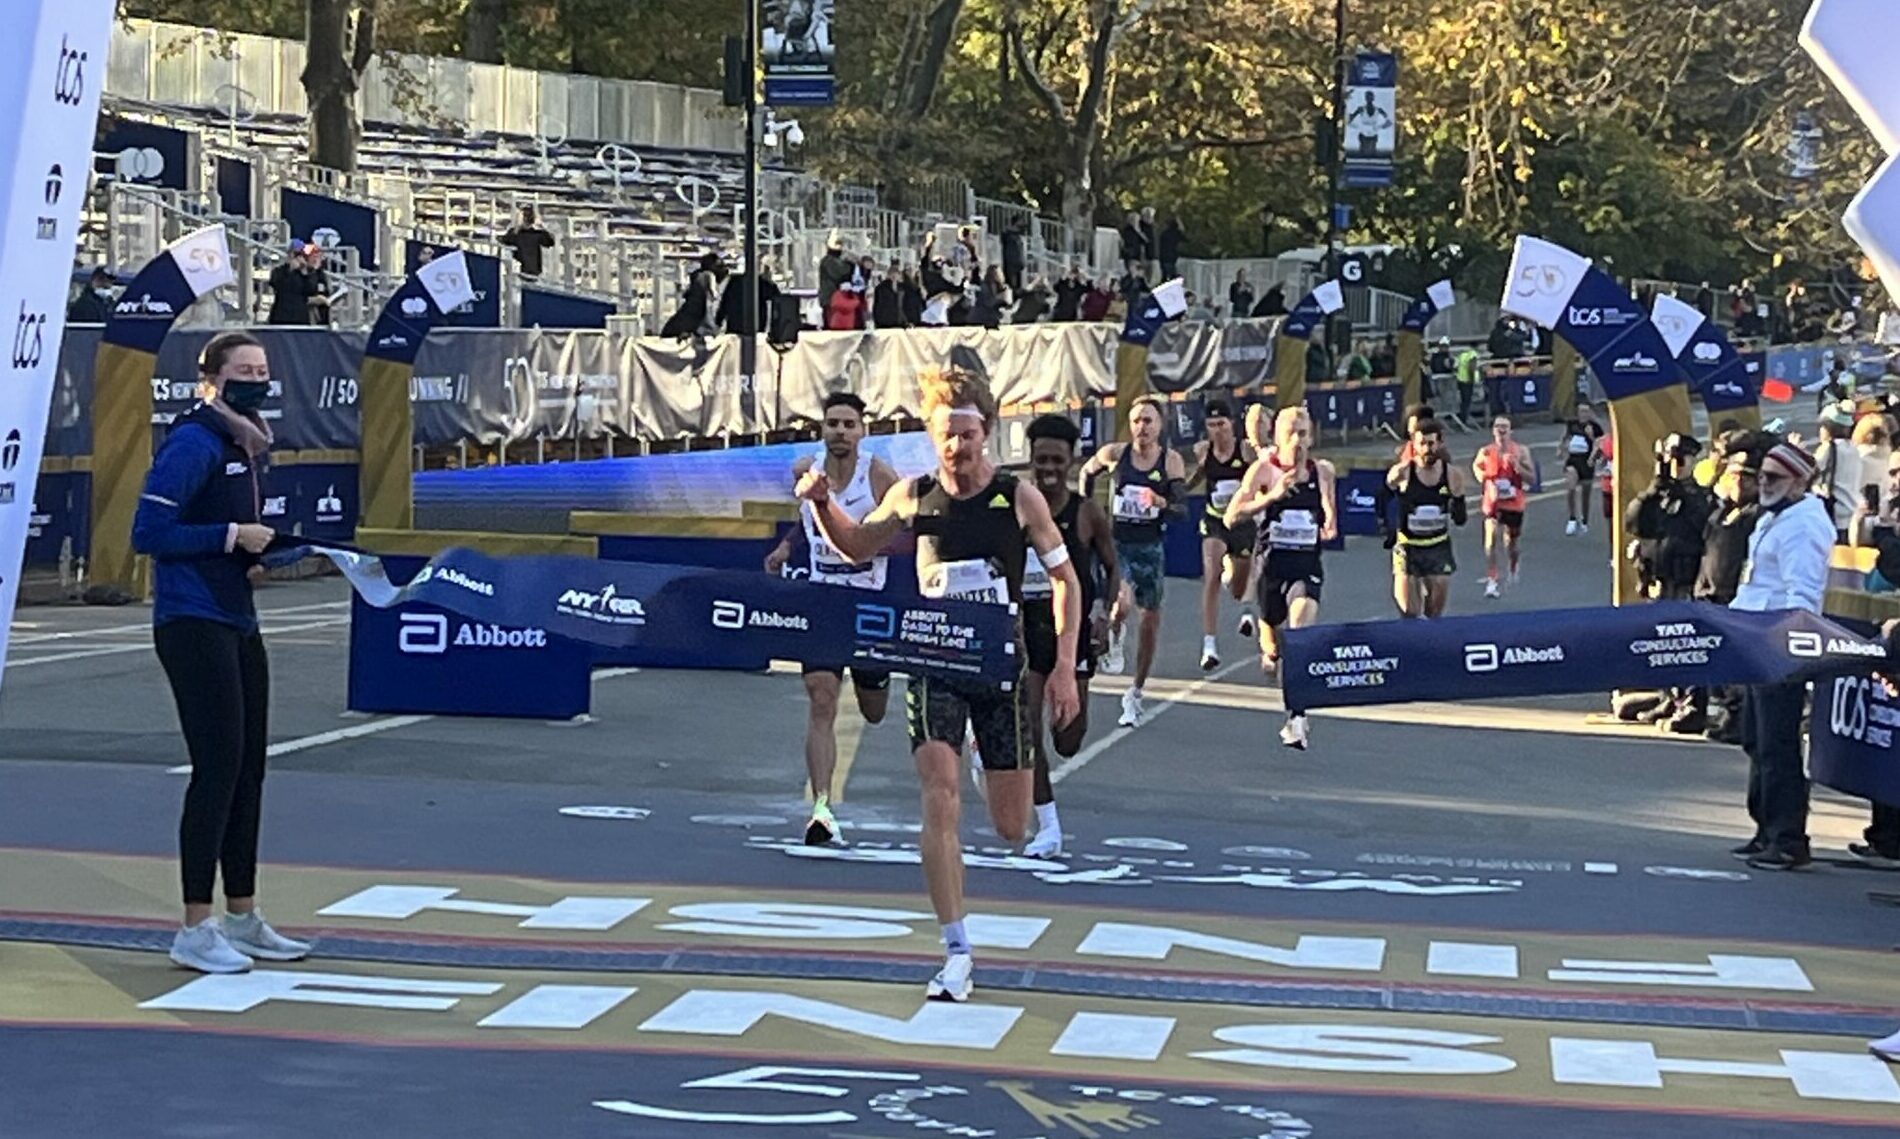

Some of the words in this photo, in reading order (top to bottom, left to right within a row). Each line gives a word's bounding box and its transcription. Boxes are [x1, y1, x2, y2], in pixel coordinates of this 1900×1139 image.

[55, 33, 87, 106] tcs
[1342, 260, 1362, 281] G
[1569, 306, 1601, 326] tcs
[12, 299, 47, 369] tcs
[434, 567, 495, 597] Abbott
[748, 610, 809, 630] Abbott
[1656, 623, 1697, 637] TATA
[453, 623, 547, 647] Abbott
[1630, 636, 1723, 654] CONSULTANCY
[1333, 645, 1373, 659] TATA
[1502, 644, 1564, 664] Abbott
[1648, 651, 1709, 668] SERVICES
[1308, 657, 1400, 676] CONSULTANCY
[1325, 672, 1385, 689] SERVICES
[316, 884, 1814, 991] FINISH
[138, 970, 1900, 1103] FINISH
